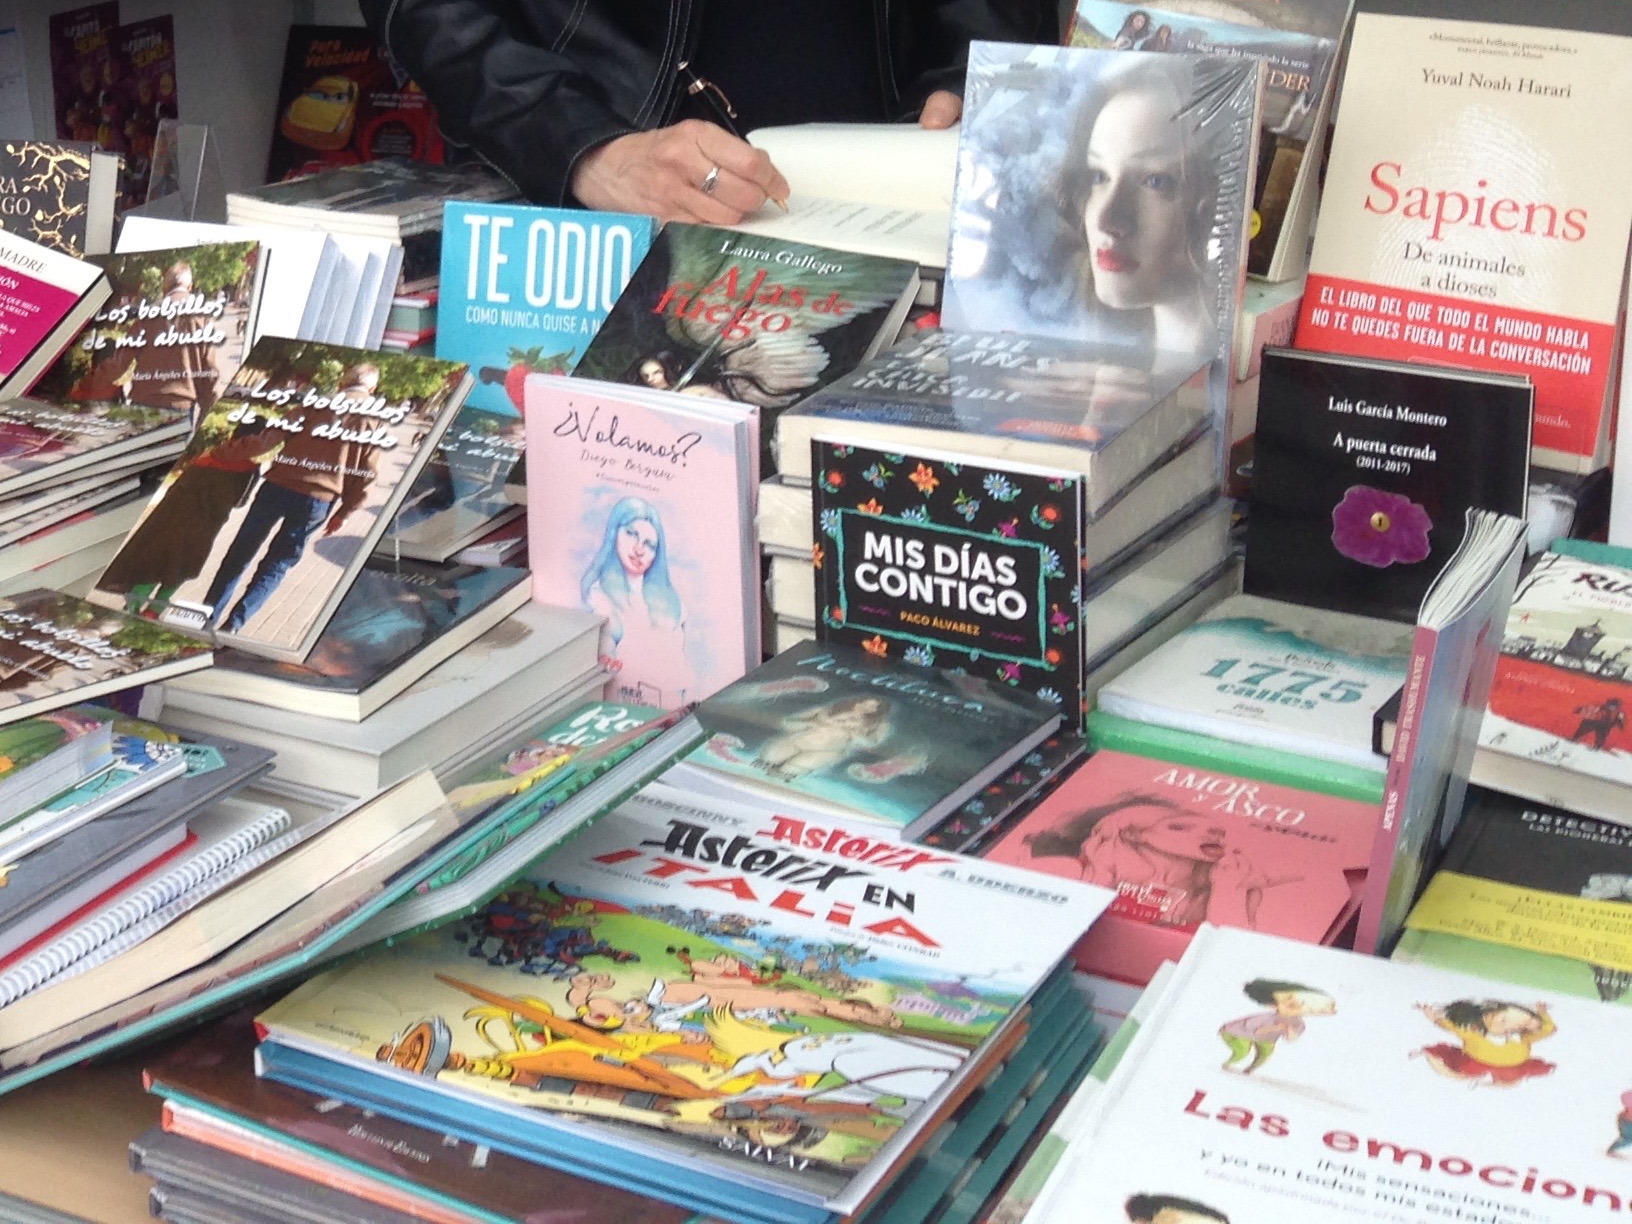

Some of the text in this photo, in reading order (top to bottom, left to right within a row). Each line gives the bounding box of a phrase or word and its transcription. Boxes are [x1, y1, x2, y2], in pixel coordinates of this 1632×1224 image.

[1420, 67, 1572, 99] Yuval Noah Harari
[1363, 161, 1589, 242] Sapiens
[463, 214, 632, 314] TE ODIO
[719, 238, 843, 275] Laura Gallego
[1402, 239, 1527, 279] De animales
[137, 291, 224, 318] bolsillos
[700, 265, 855, 317] Alas de
[1421, 272, 1498, 300] a dioses
[465, 304, 588, 335] COMO NUNCA QUISE A
[651, 281, 793, 342] fuego
[1319, 285, 1590, 351] EL LIBRO DEL QUE TODO EL MUNDO HABLA
[82, 326, 225, 350] de mi abuelo
[1311, 307, 1593, 377] NO TE QUEDES FUERA DE LA CONVERSACIÓN
[250, 379, 412, 424] Los bolsillos
[1328, 396, 1448, 429] Luis García Montero
[226, 402, 398, 450] de mi abuelo
[553, 401, 703, 470] ¿Volamos?
[580, 448, 620, 472] Diego
[1332, 433, 1437, 462] A puerta cerrada
[1356, 455, 1412, 476] (2011-2017)
[863, 530, 1018, 588] MIS DÍAS
[853, 561, 1029, 623] CONTIGO
[900, 609, 982, 638] PACO ÁLVAREZ
[1203, 658, 1368, 704] 1775
[1153, 766, 1263, 802] AMOR
[1213, 797, 1308, 827] ASCO
[862, 883, 918, 914] EN
[1182, 1088, 1292, 1140] Las
